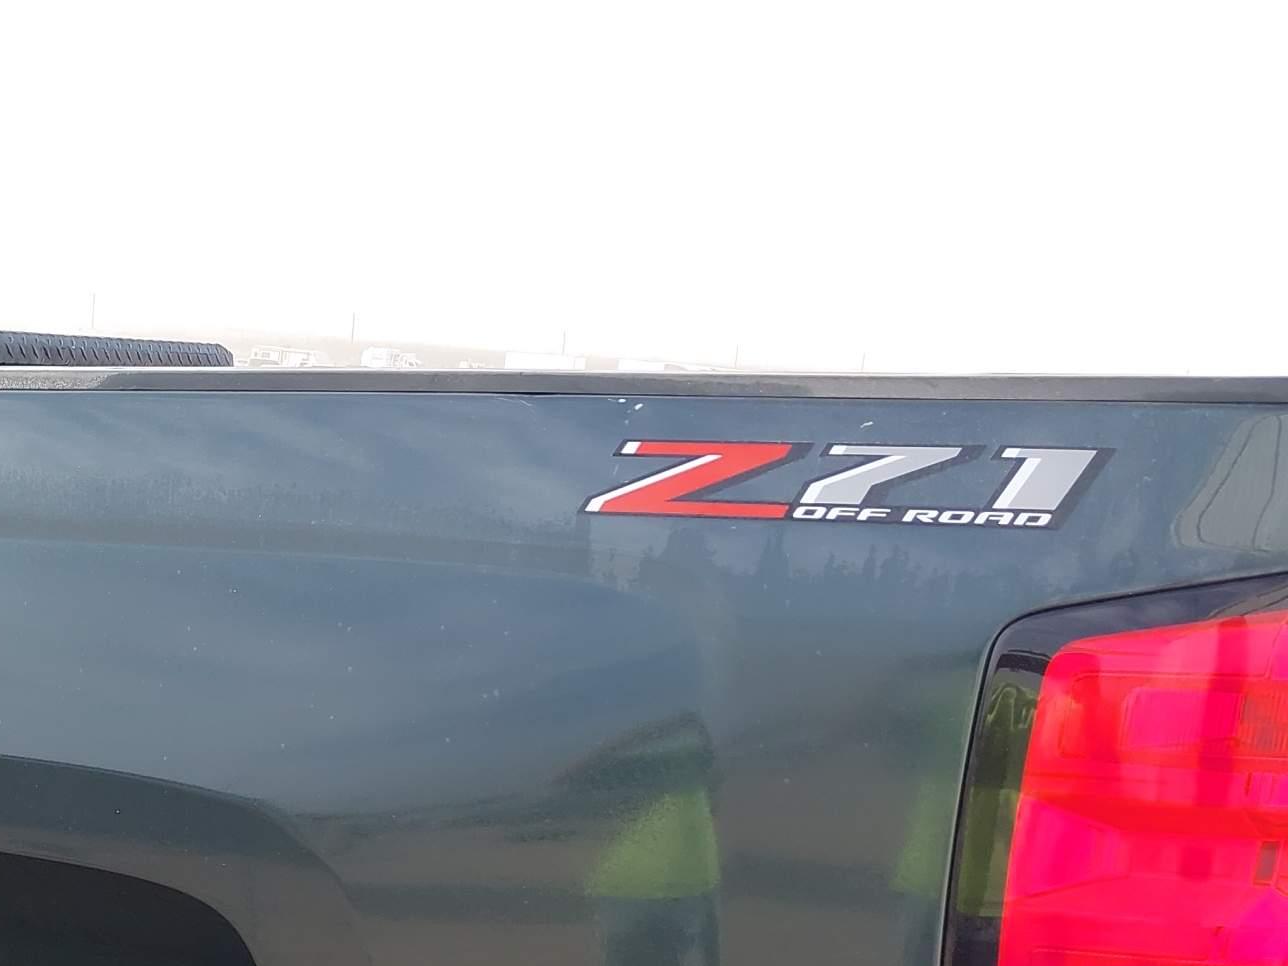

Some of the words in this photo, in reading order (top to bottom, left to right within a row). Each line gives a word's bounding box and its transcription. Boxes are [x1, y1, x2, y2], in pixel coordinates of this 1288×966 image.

[581, 440, 1104, 518] Z71
[792, 506, 891, 521] OFF
[902, 509, 1052, 526] ROAD
